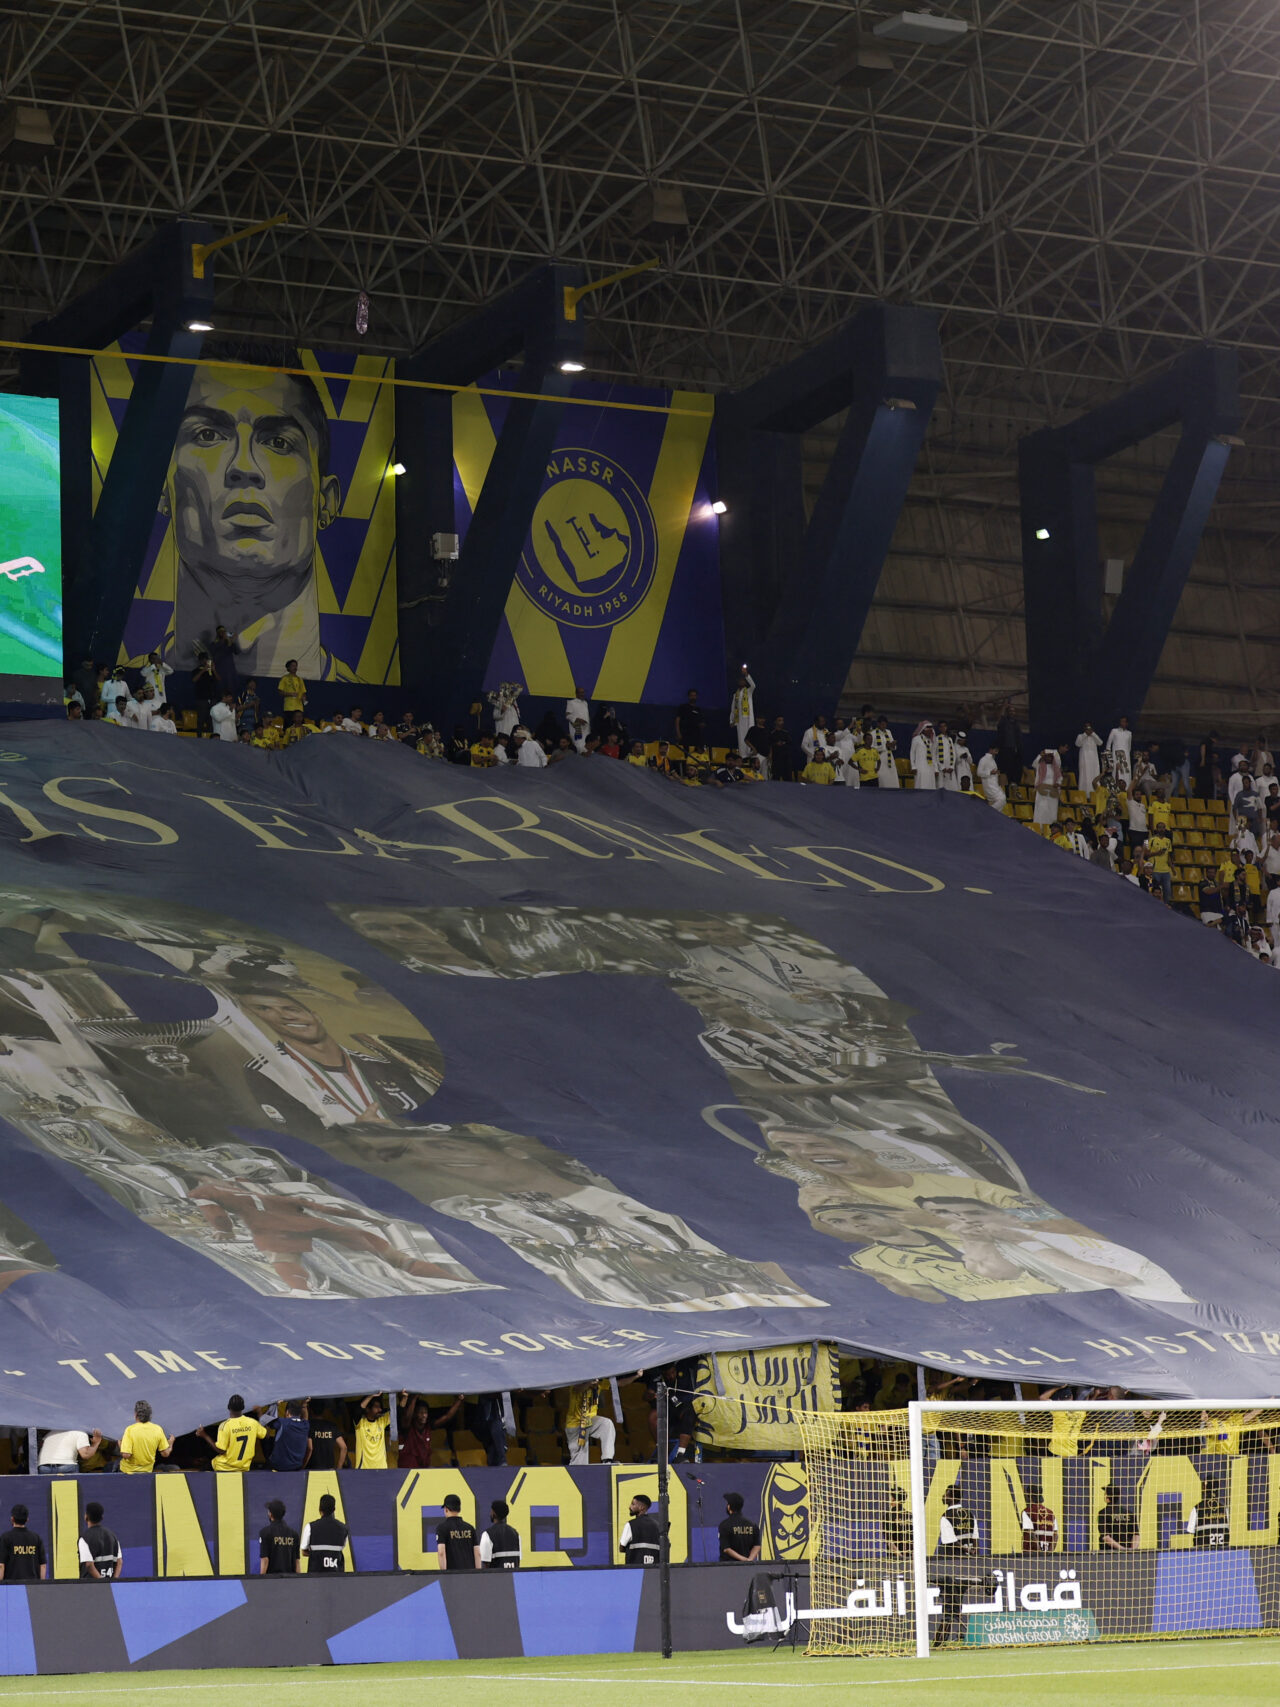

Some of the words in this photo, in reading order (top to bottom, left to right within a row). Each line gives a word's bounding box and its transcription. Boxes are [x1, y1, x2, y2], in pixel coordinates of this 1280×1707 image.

[546, 457, 615, 485] NASSR
[538, 584, 593, 617] RIYADH
[599, 591, 628, 615] 1955
[57, 1348, 244, 1387] TIME
[257, 1340, 387, 1362] TOP
[418, 1328, 665, 1357] SCORER
[727, 1347, 818, 1397] فرسان
[236, 1434, 250, 1461] 7
[449, 1529, 472, 1540] POLICE
[733, 1526, 754, 1535] POLICE
[13, 1545, 37, 1556] POLICE
[273, 1536, 295, 1546] POLICE
[987, 1631, 1024, 1644] ROSHN
[1025, 1630, 1062, 1643] GROUP
